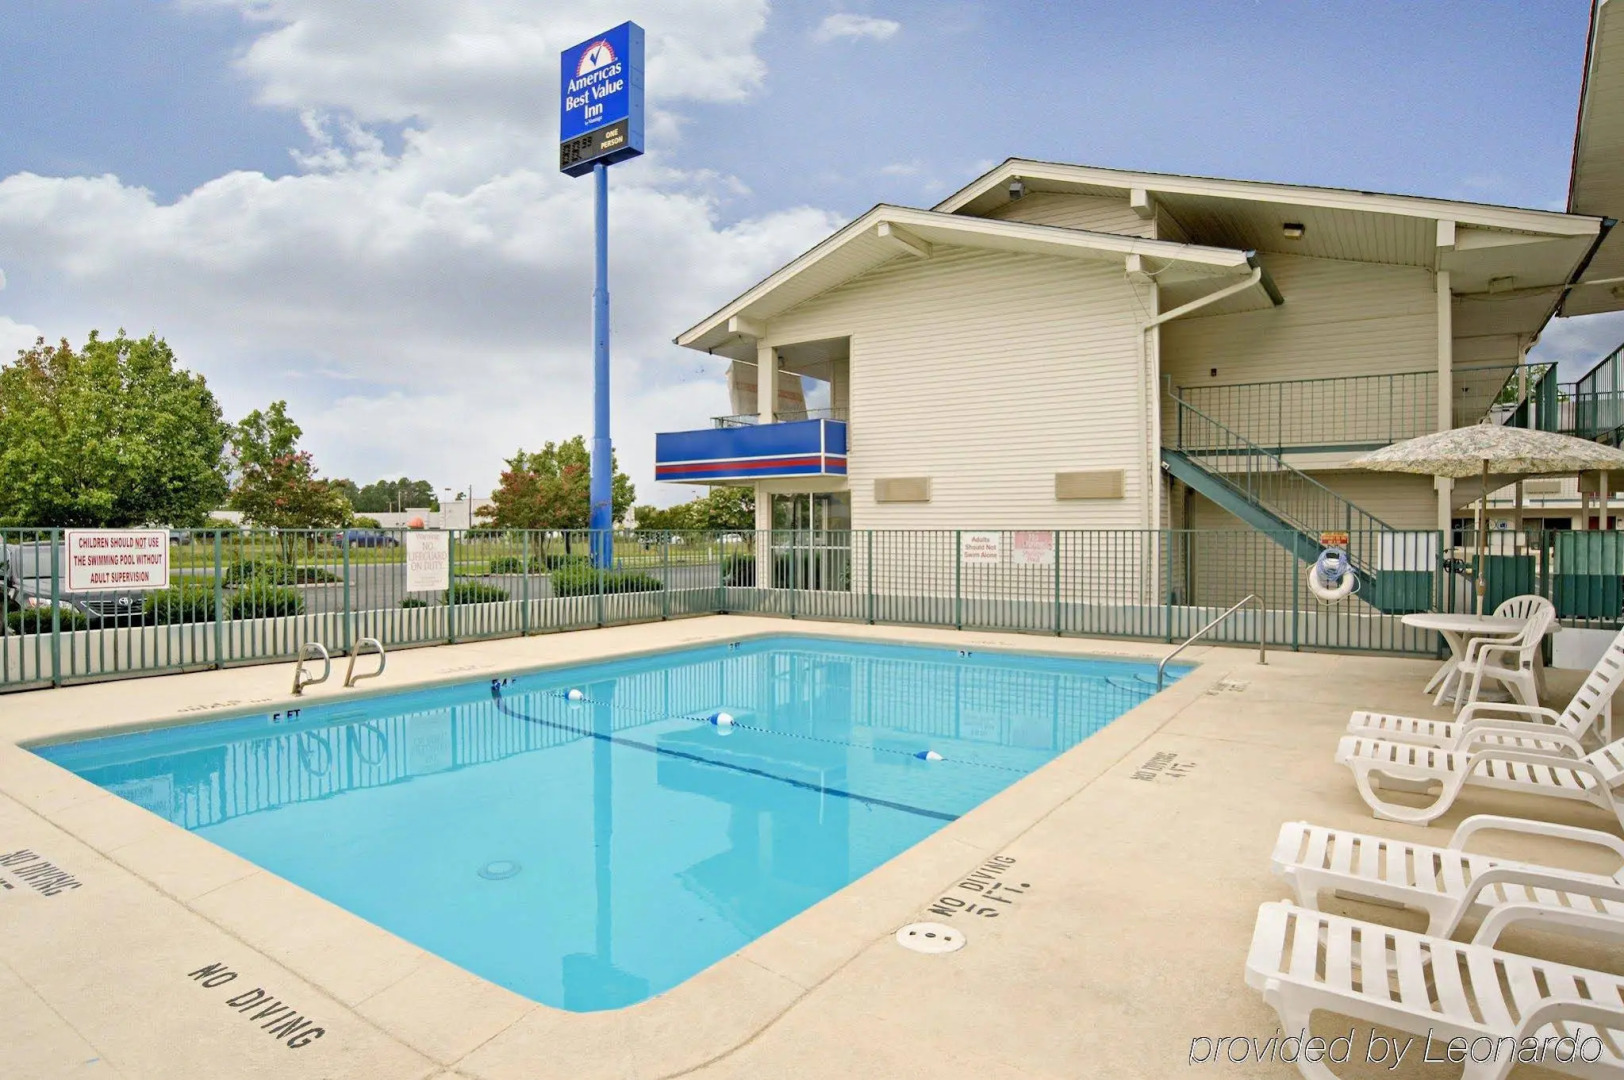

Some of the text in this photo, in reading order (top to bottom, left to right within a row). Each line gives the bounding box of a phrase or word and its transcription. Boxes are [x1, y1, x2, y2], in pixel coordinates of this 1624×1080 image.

[568, 63, 621, 94] Americas
[566, 80, 623, 111] Best Value
[584, 103, 603, 119] Inn
[605, 129, 619, 138] ONE
[600, 136, 623, 149] PERSON
[79, 538, 159, 549] CHILDREN SHOULD NOT USE
[422, 542, 434, 550] NO
[74, 555, 162, 566] THE SWIMMING POOL WITHOUT
[980, 551, 998, 559] Alone
[410, 561, 443, 571] ON DUTY
[90, 571, 150, 584] ADULT SUPERVISION
[11, 861, 83, 896] DIVING
[927, 856, 1016, 917] NO DIVING
[187, 962, 326, 1049] NO DIVING
